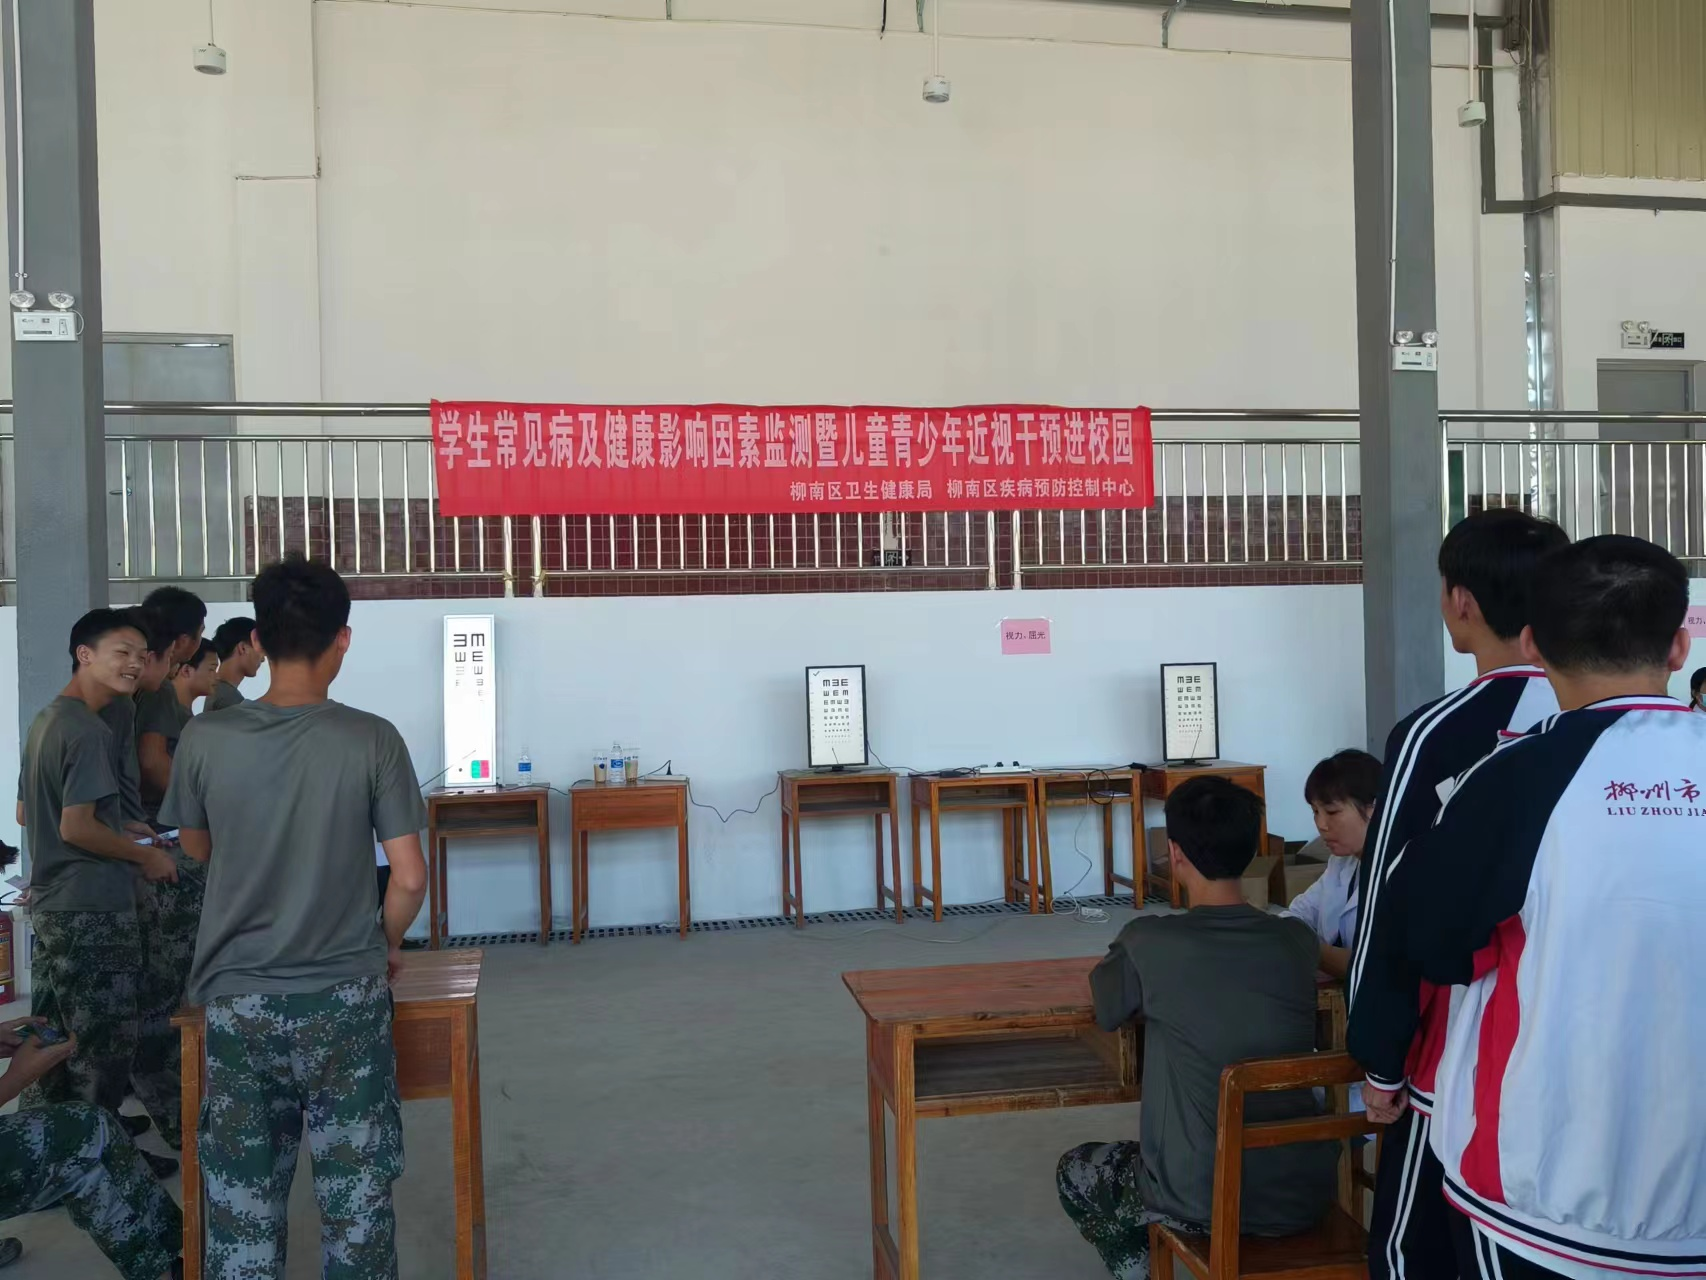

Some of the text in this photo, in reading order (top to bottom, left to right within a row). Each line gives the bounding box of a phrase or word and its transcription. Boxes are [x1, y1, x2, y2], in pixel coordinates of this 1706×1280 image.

[438, 408, 1135, 470] 学生常见病及健康影响因素监测暨儿童青少年近视干预进校园
[789, 477, 1136, 502] 柳南区卫生健康局 柳南区疾病预防控制中心
[1603, 778, 1701, 804] 柳州市
[1607, 807, 1636, 816] LIU
[1640, 807, 1683, 816] ZHOU
